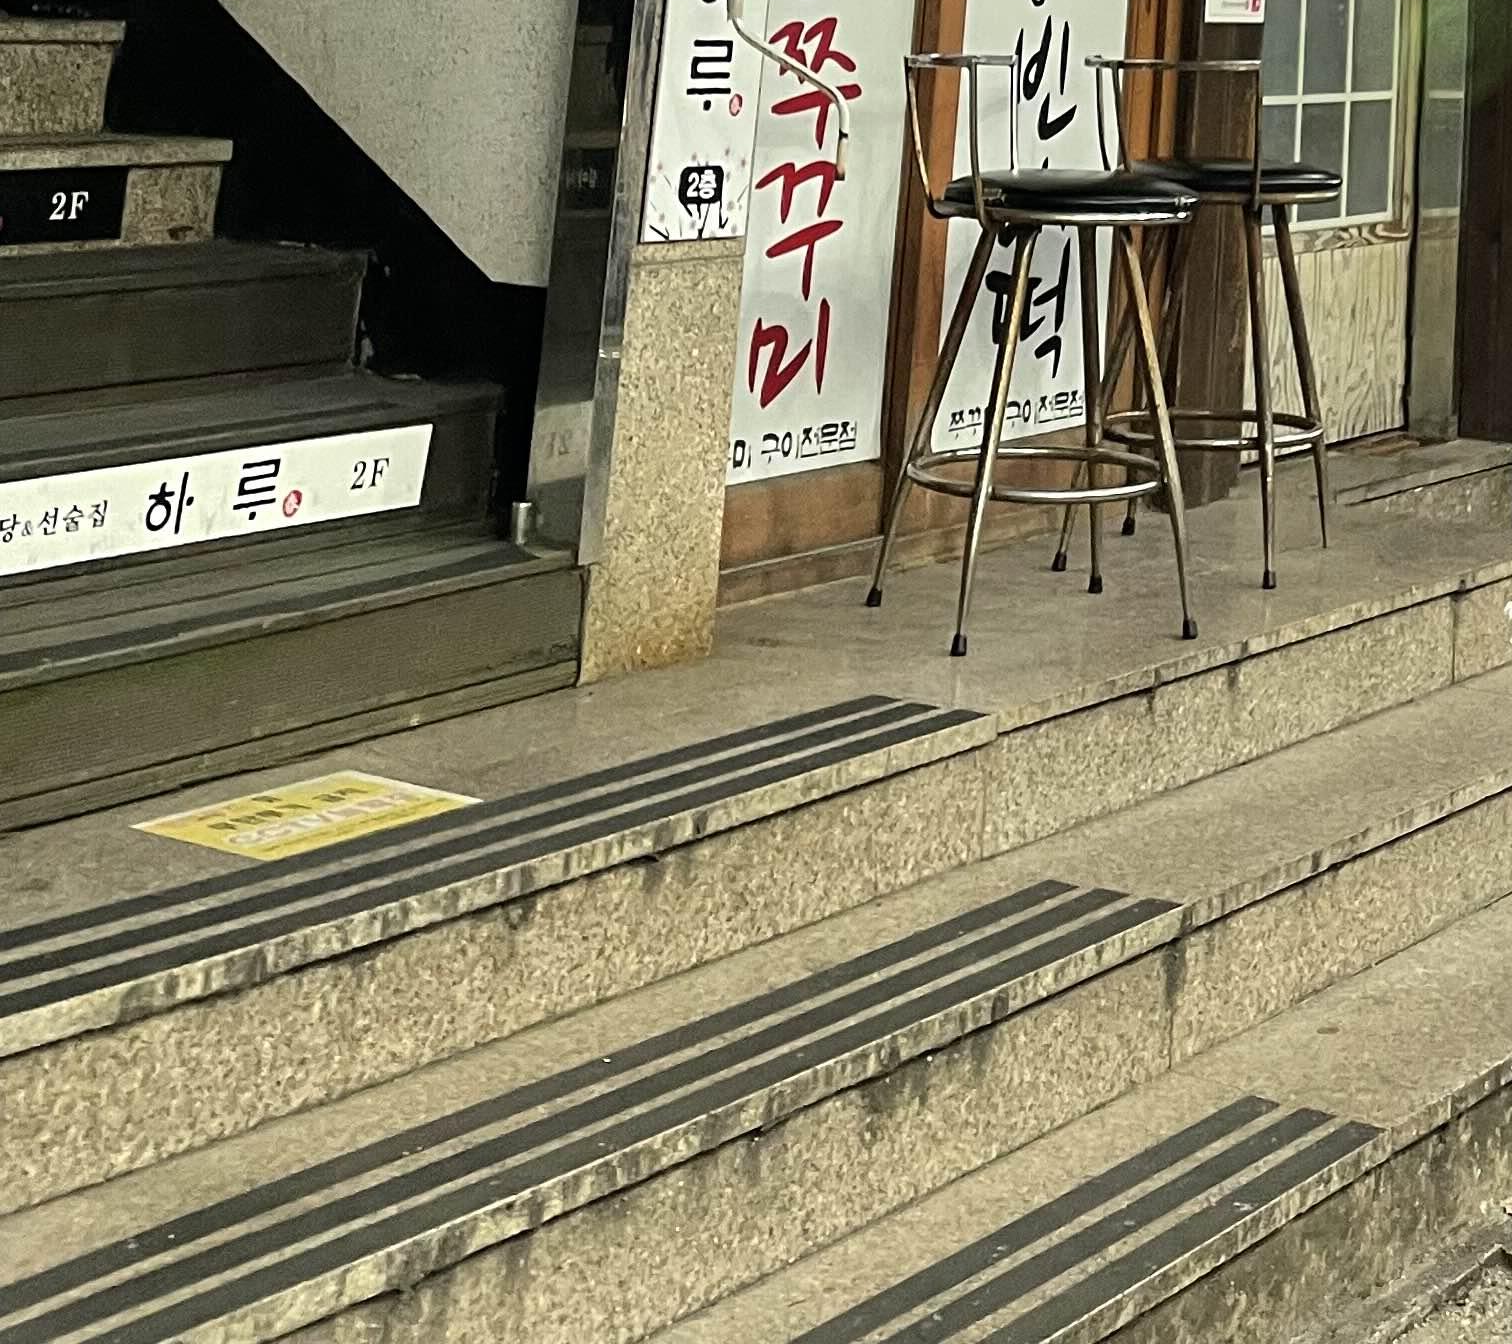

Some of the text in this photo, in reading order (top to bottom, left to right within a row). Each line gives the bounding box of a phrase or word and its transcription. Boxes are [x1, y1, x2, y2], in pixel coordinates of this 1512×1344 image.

[48, 191, 89, 221] 2F
[686, 169, 718, 201] 2층
[747, 15, 863, 411] 쭈꾸미
[986, 14, 1078, 380] 빈떡
[145, 458, 282, 535] 하루
[349, 457, 391, 491] 2F
